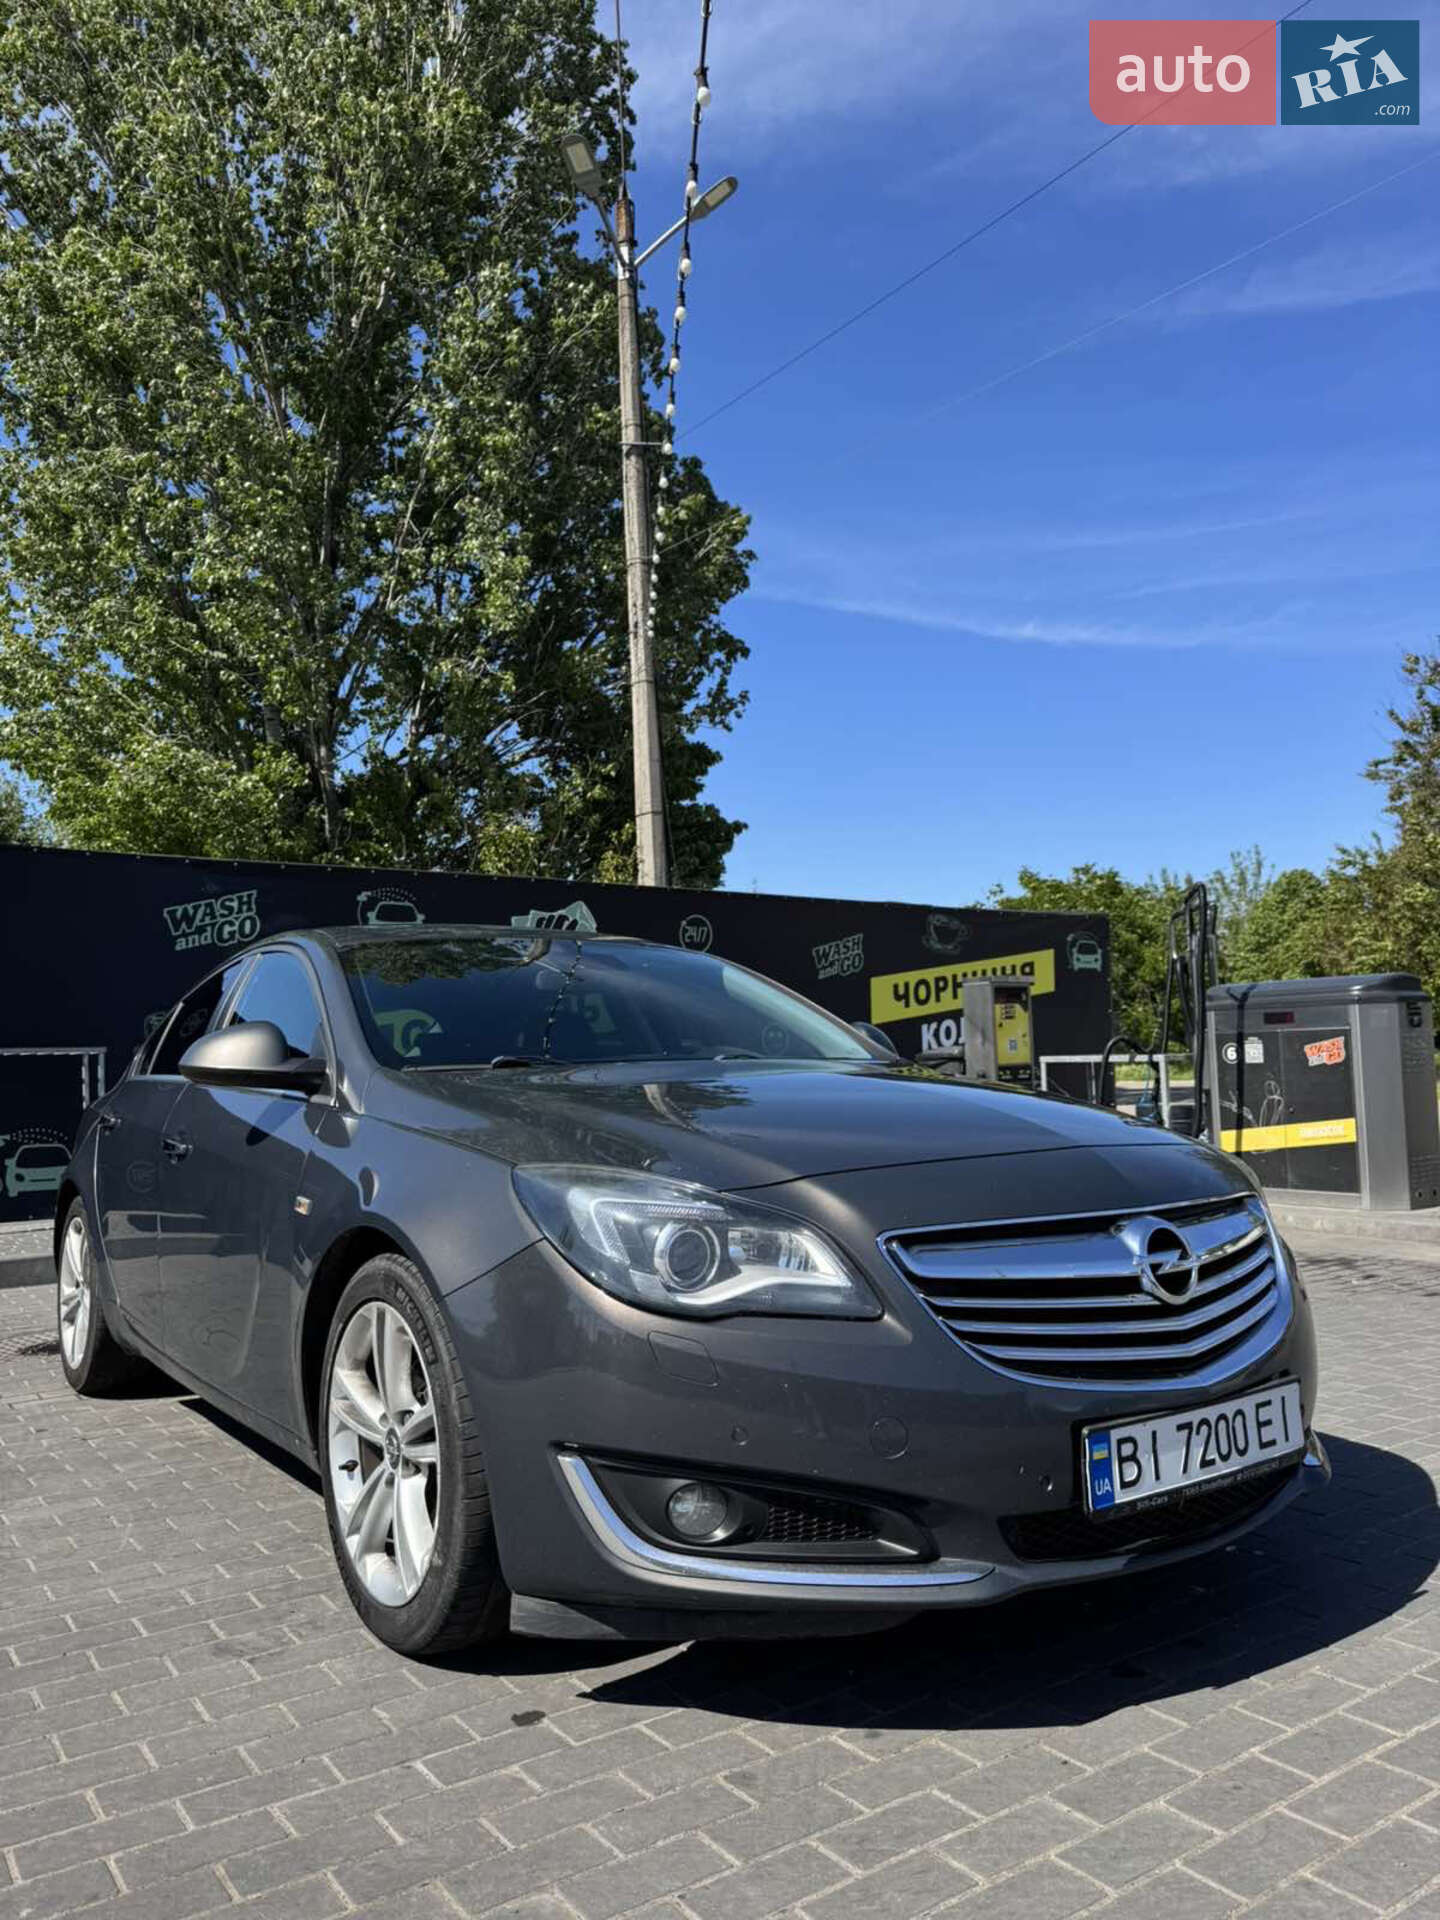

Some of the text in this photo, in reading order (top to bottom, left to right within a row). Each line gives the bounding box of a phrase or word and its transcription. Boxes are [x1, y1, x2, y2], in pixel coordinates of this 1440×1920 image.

[163, 890, 257, 936] WASH
[175, 914, 260, 951] and GO
[812, 933, 863, 968] WASH
[839, 950, 864, 976] GO
[1116, 1430, 1161, 1490] BI
[1176, 1408, 1250, 1475] 7200
[1254, 1396, 1290, 1450] EI
[1095, 1479, 1113, 1496] UA
